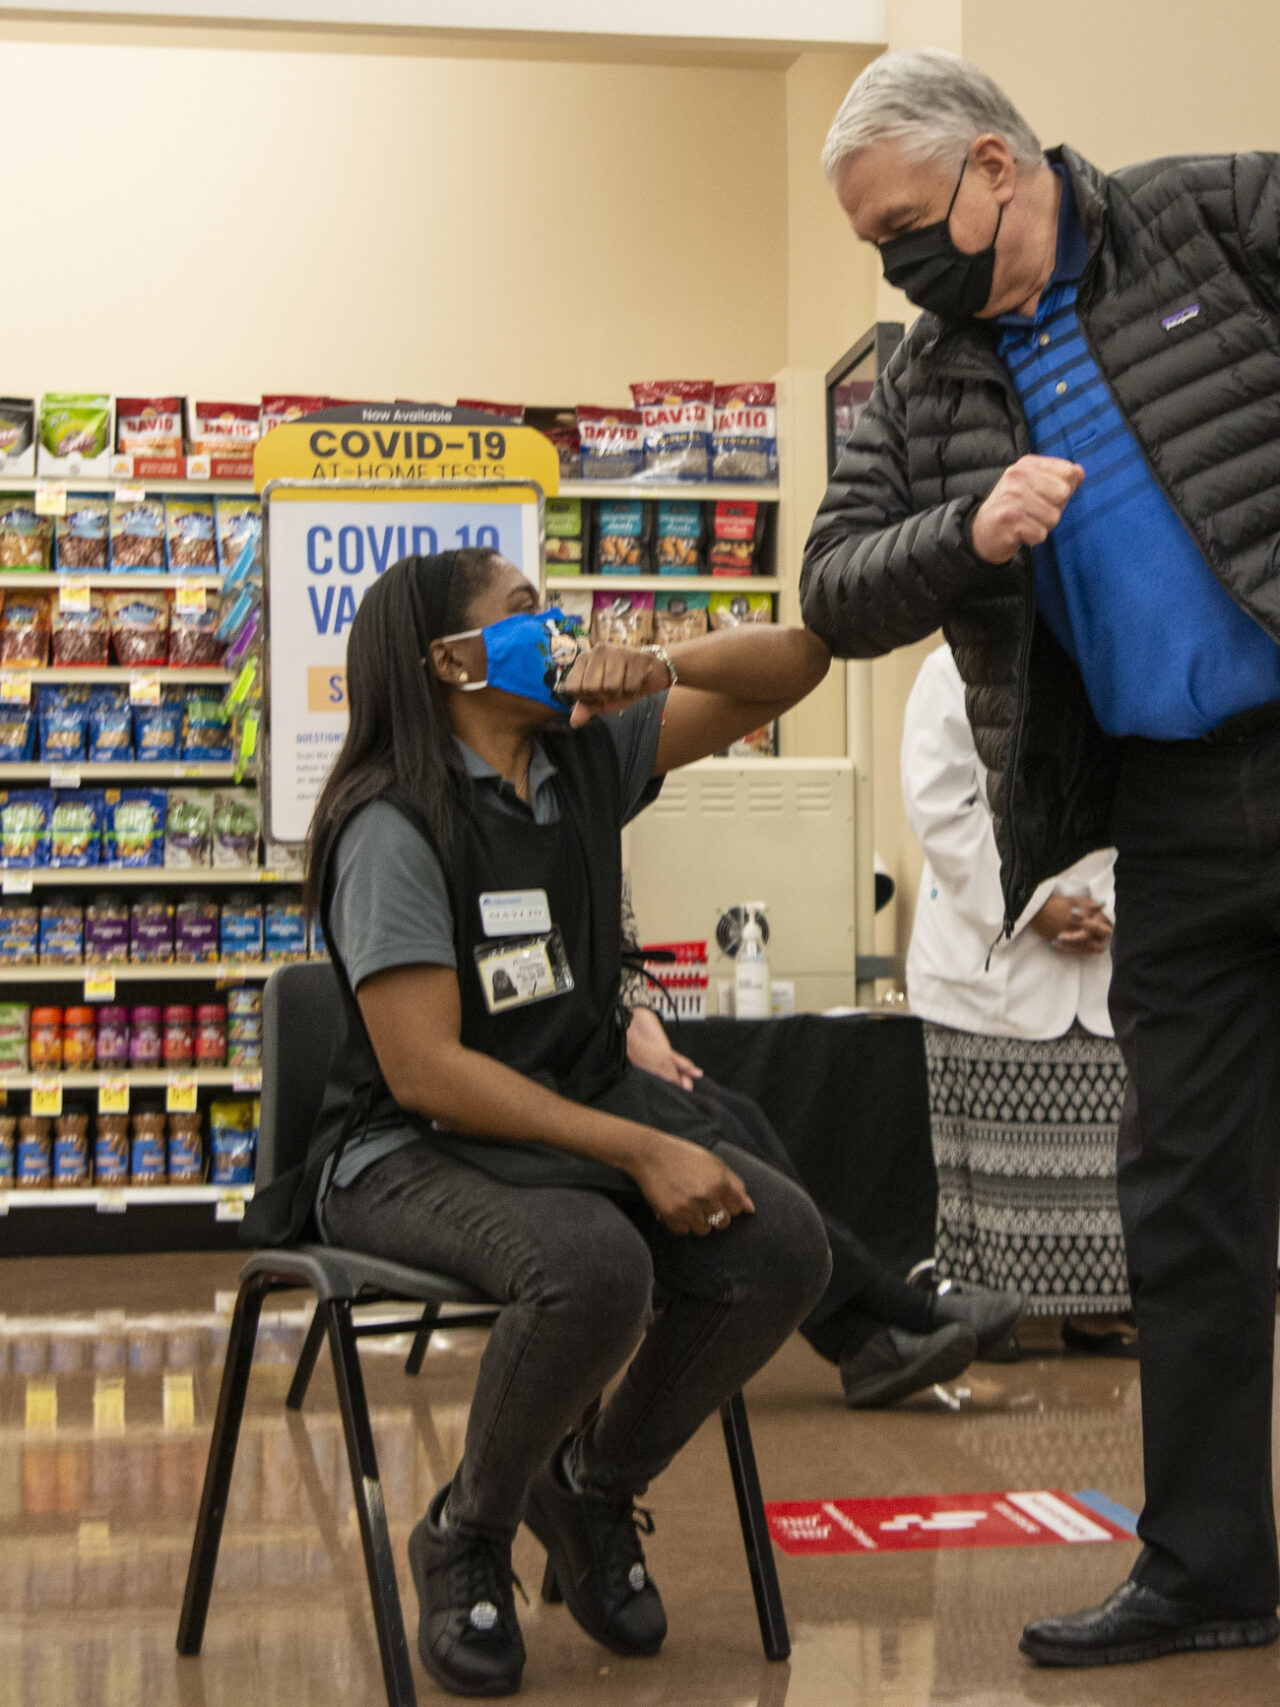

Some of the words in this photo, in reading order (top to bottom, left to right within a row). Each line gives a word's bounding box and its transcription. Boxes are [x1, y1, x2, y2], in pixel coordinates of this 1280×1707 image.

[362, 408, 391, 422] Now
[393, 408, 453, 423] Available
[643, 404, 706, 428] DAVID
[713, 410, 767, 431] AVID
[309, 429, 507, 461] COVID-19
[312, 462, 428, 480] AT-HOME
[437, 463, 506, 481] TESTS
